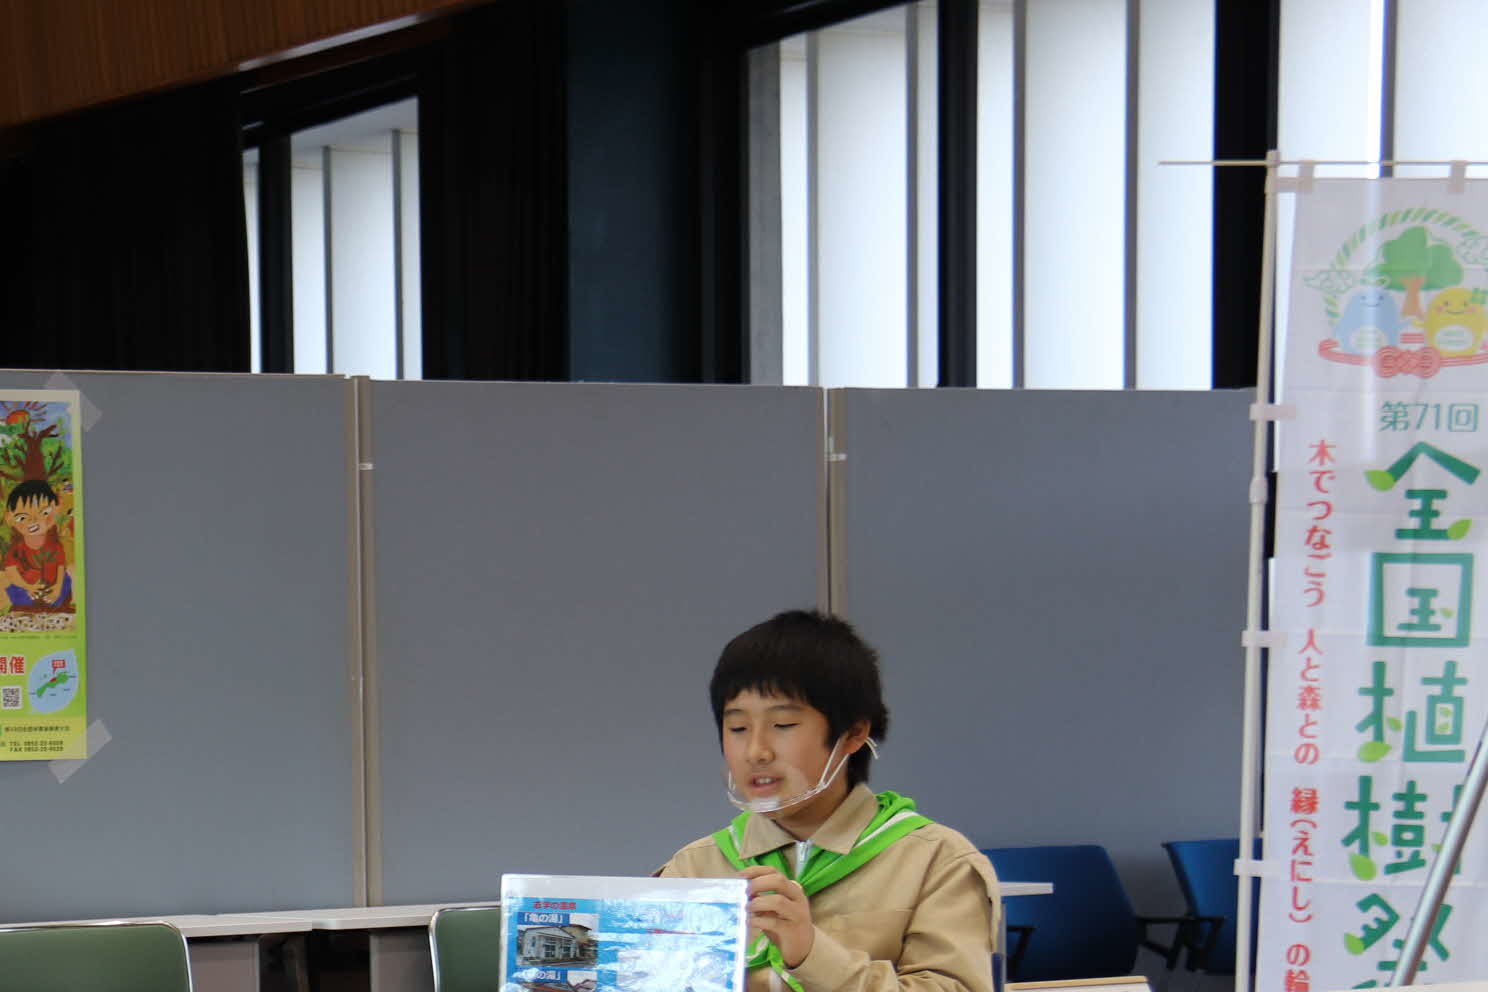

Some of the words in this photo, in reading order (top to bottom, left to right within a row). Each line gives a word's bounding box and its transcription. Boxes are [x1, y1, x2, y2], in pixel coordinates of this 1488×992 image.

[1379, 402, 1480, 433] 第71回
[1302, 440, 1337, 608] 木でつなごう
[1294, 628, 1324, 766] 人と森との
